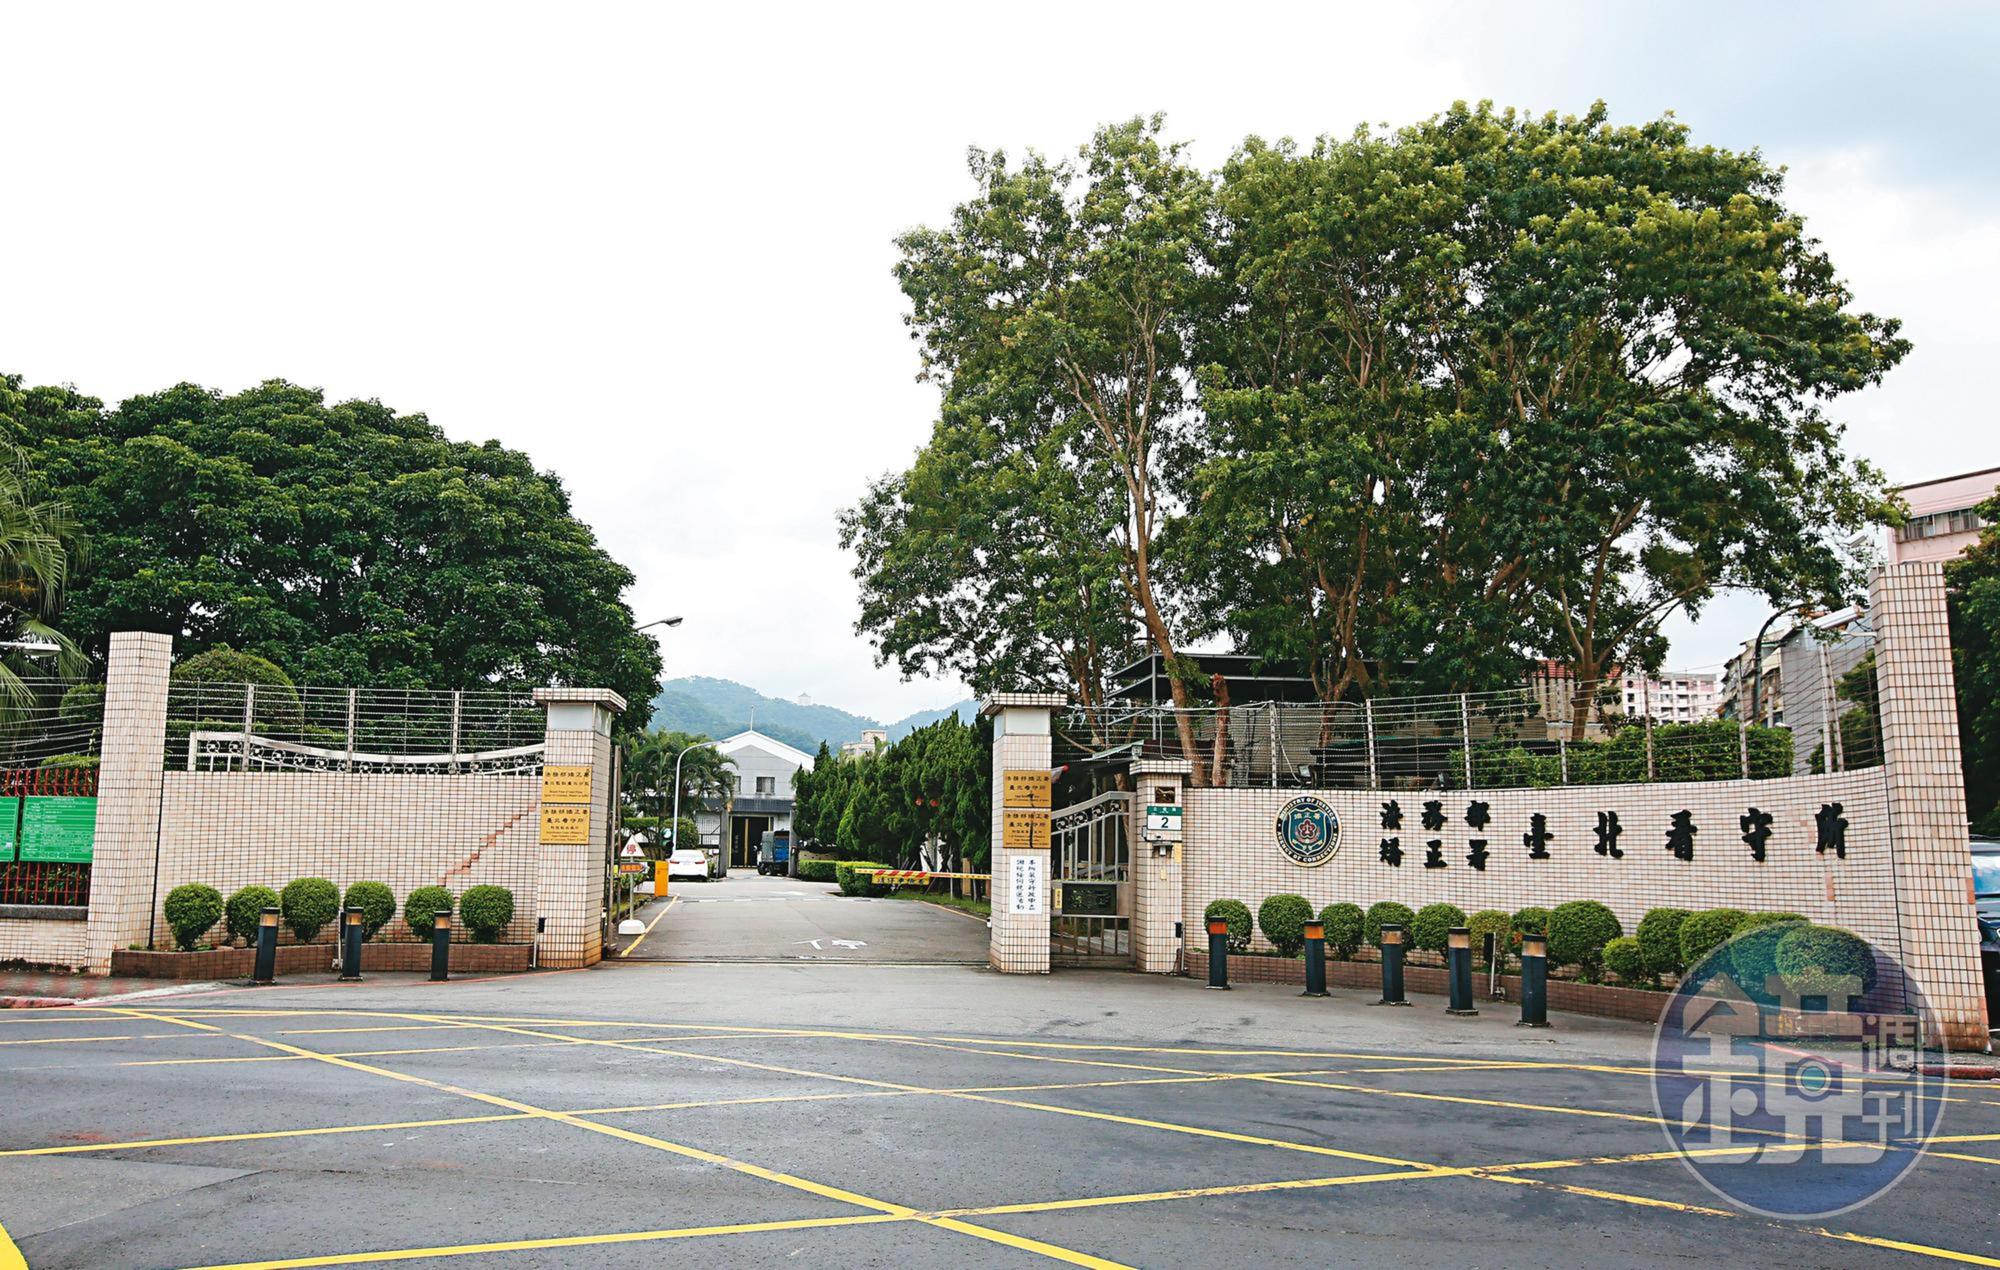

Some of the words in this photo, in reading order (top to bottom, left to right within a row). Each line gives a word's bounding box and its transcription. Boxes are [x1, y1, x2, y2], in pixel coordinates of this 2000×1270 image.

[1161, 816, 1169, 828] 2
[1379, 799, 1491, 832] 法務部
